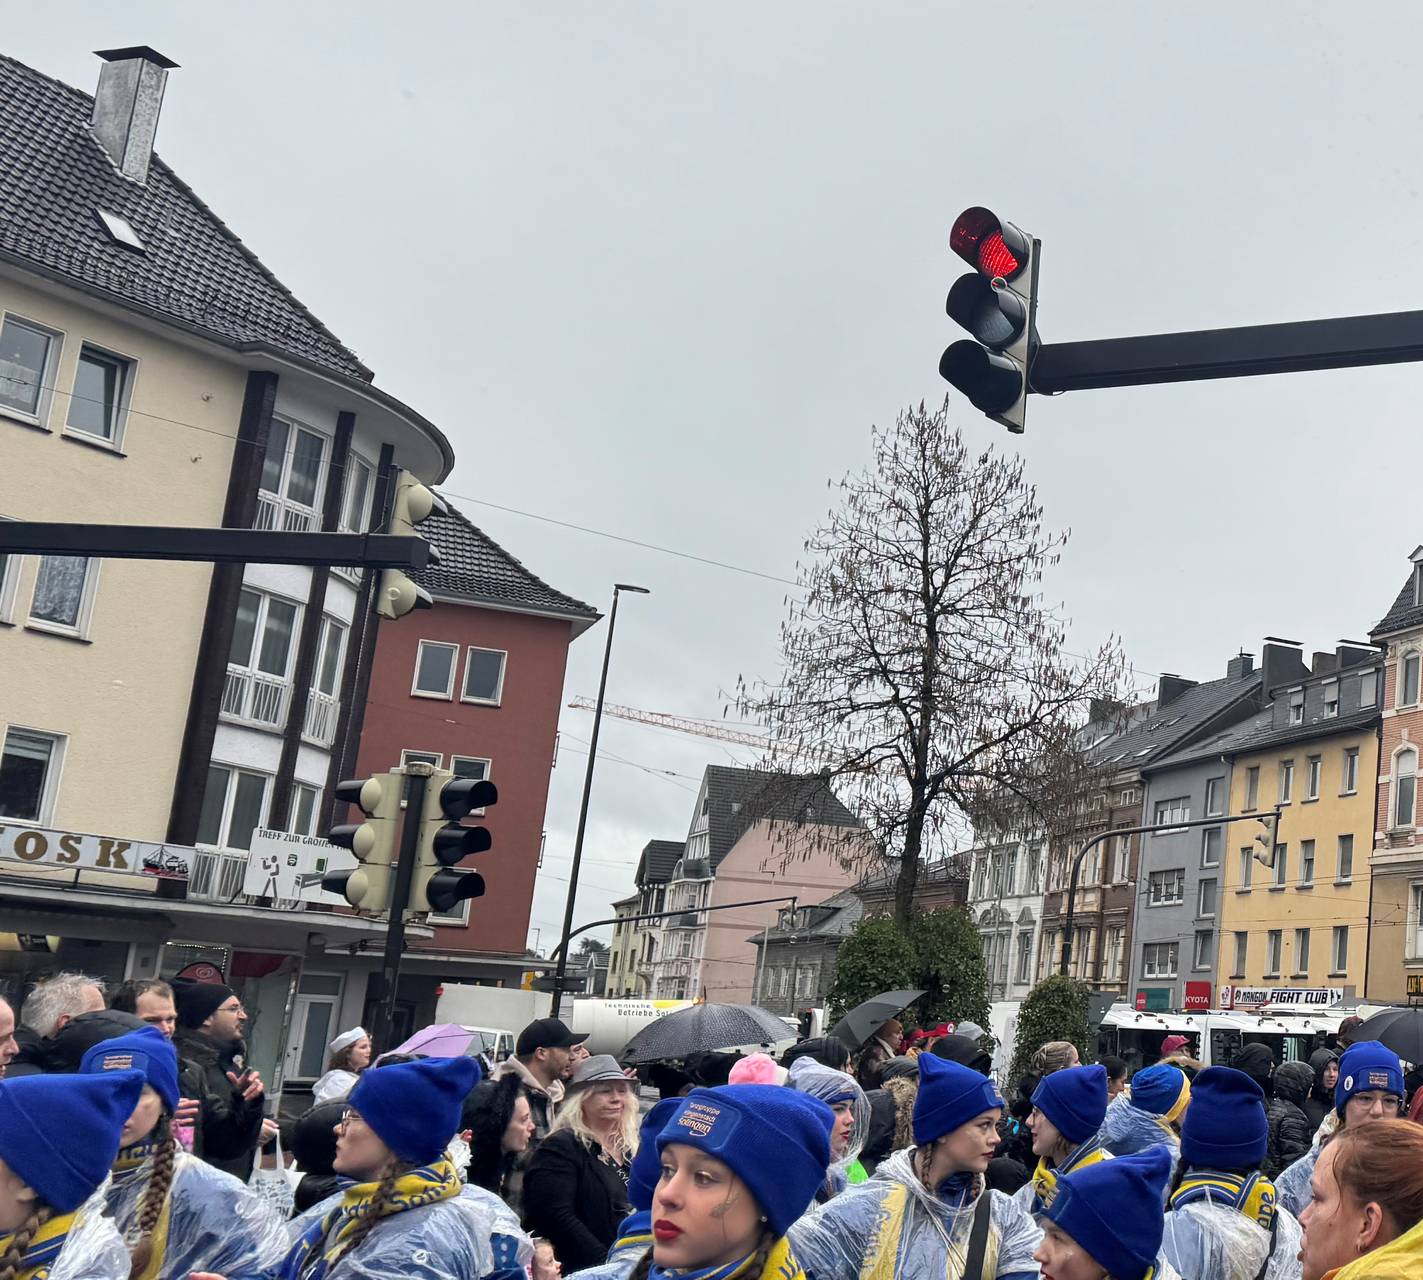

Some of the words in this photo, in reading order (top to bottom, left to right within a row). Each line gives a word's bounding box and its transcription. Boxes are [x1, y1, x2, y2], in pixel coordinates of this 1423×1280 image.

[258, 829, 282, 841] TREFF
[283, 833, 301, 844] ZUR
[0, 827, 131, 869] OSK
[1270, 991, 1303, 1004] FIGHT
[1304, 991, 1328, 1004] CLUB
[617, 1008, 653, 1018] Betriebe
